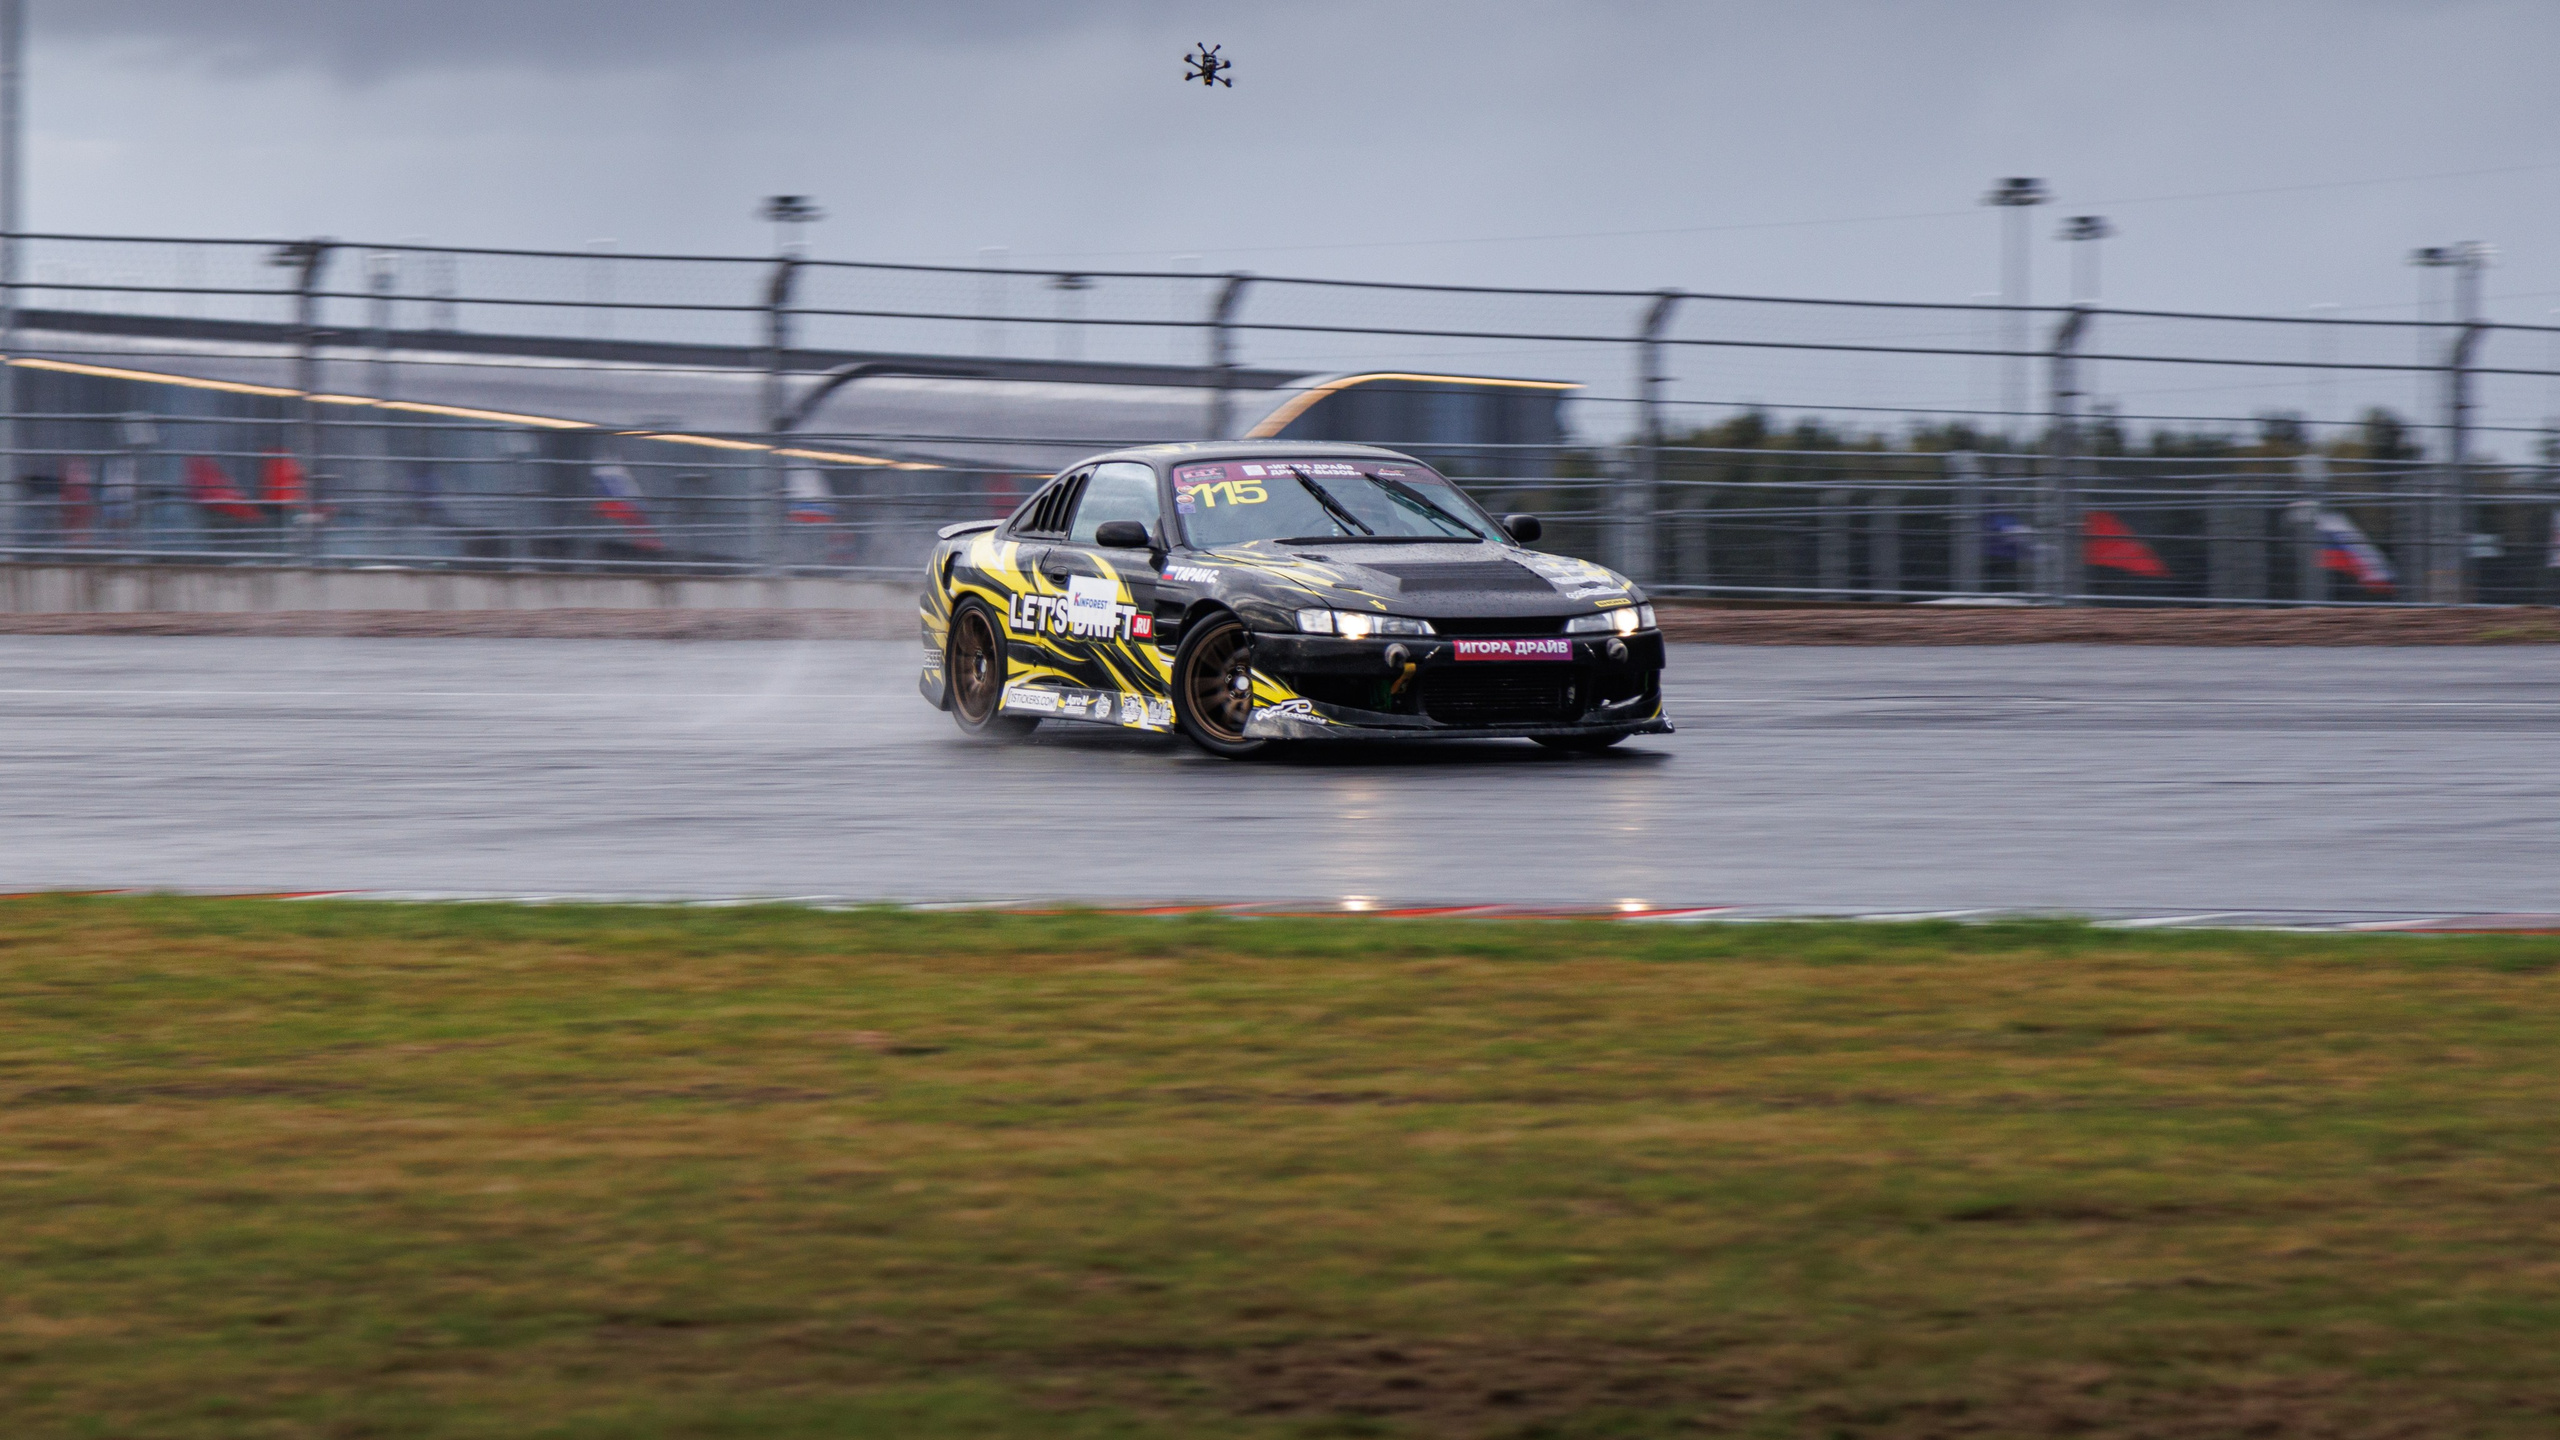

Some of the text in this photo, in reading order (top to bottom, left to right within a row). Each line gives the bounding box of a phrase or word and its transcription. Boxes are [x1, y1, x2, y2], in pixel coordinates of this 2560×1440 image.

[1188, 480, 1268, 507] 115
[1174, 566, 1210, 582] ТАРАН
[1010, 593, 1069, 634] LET'S
[1459, 640, 1568, 655] ИГОРА ДРАЙВ
